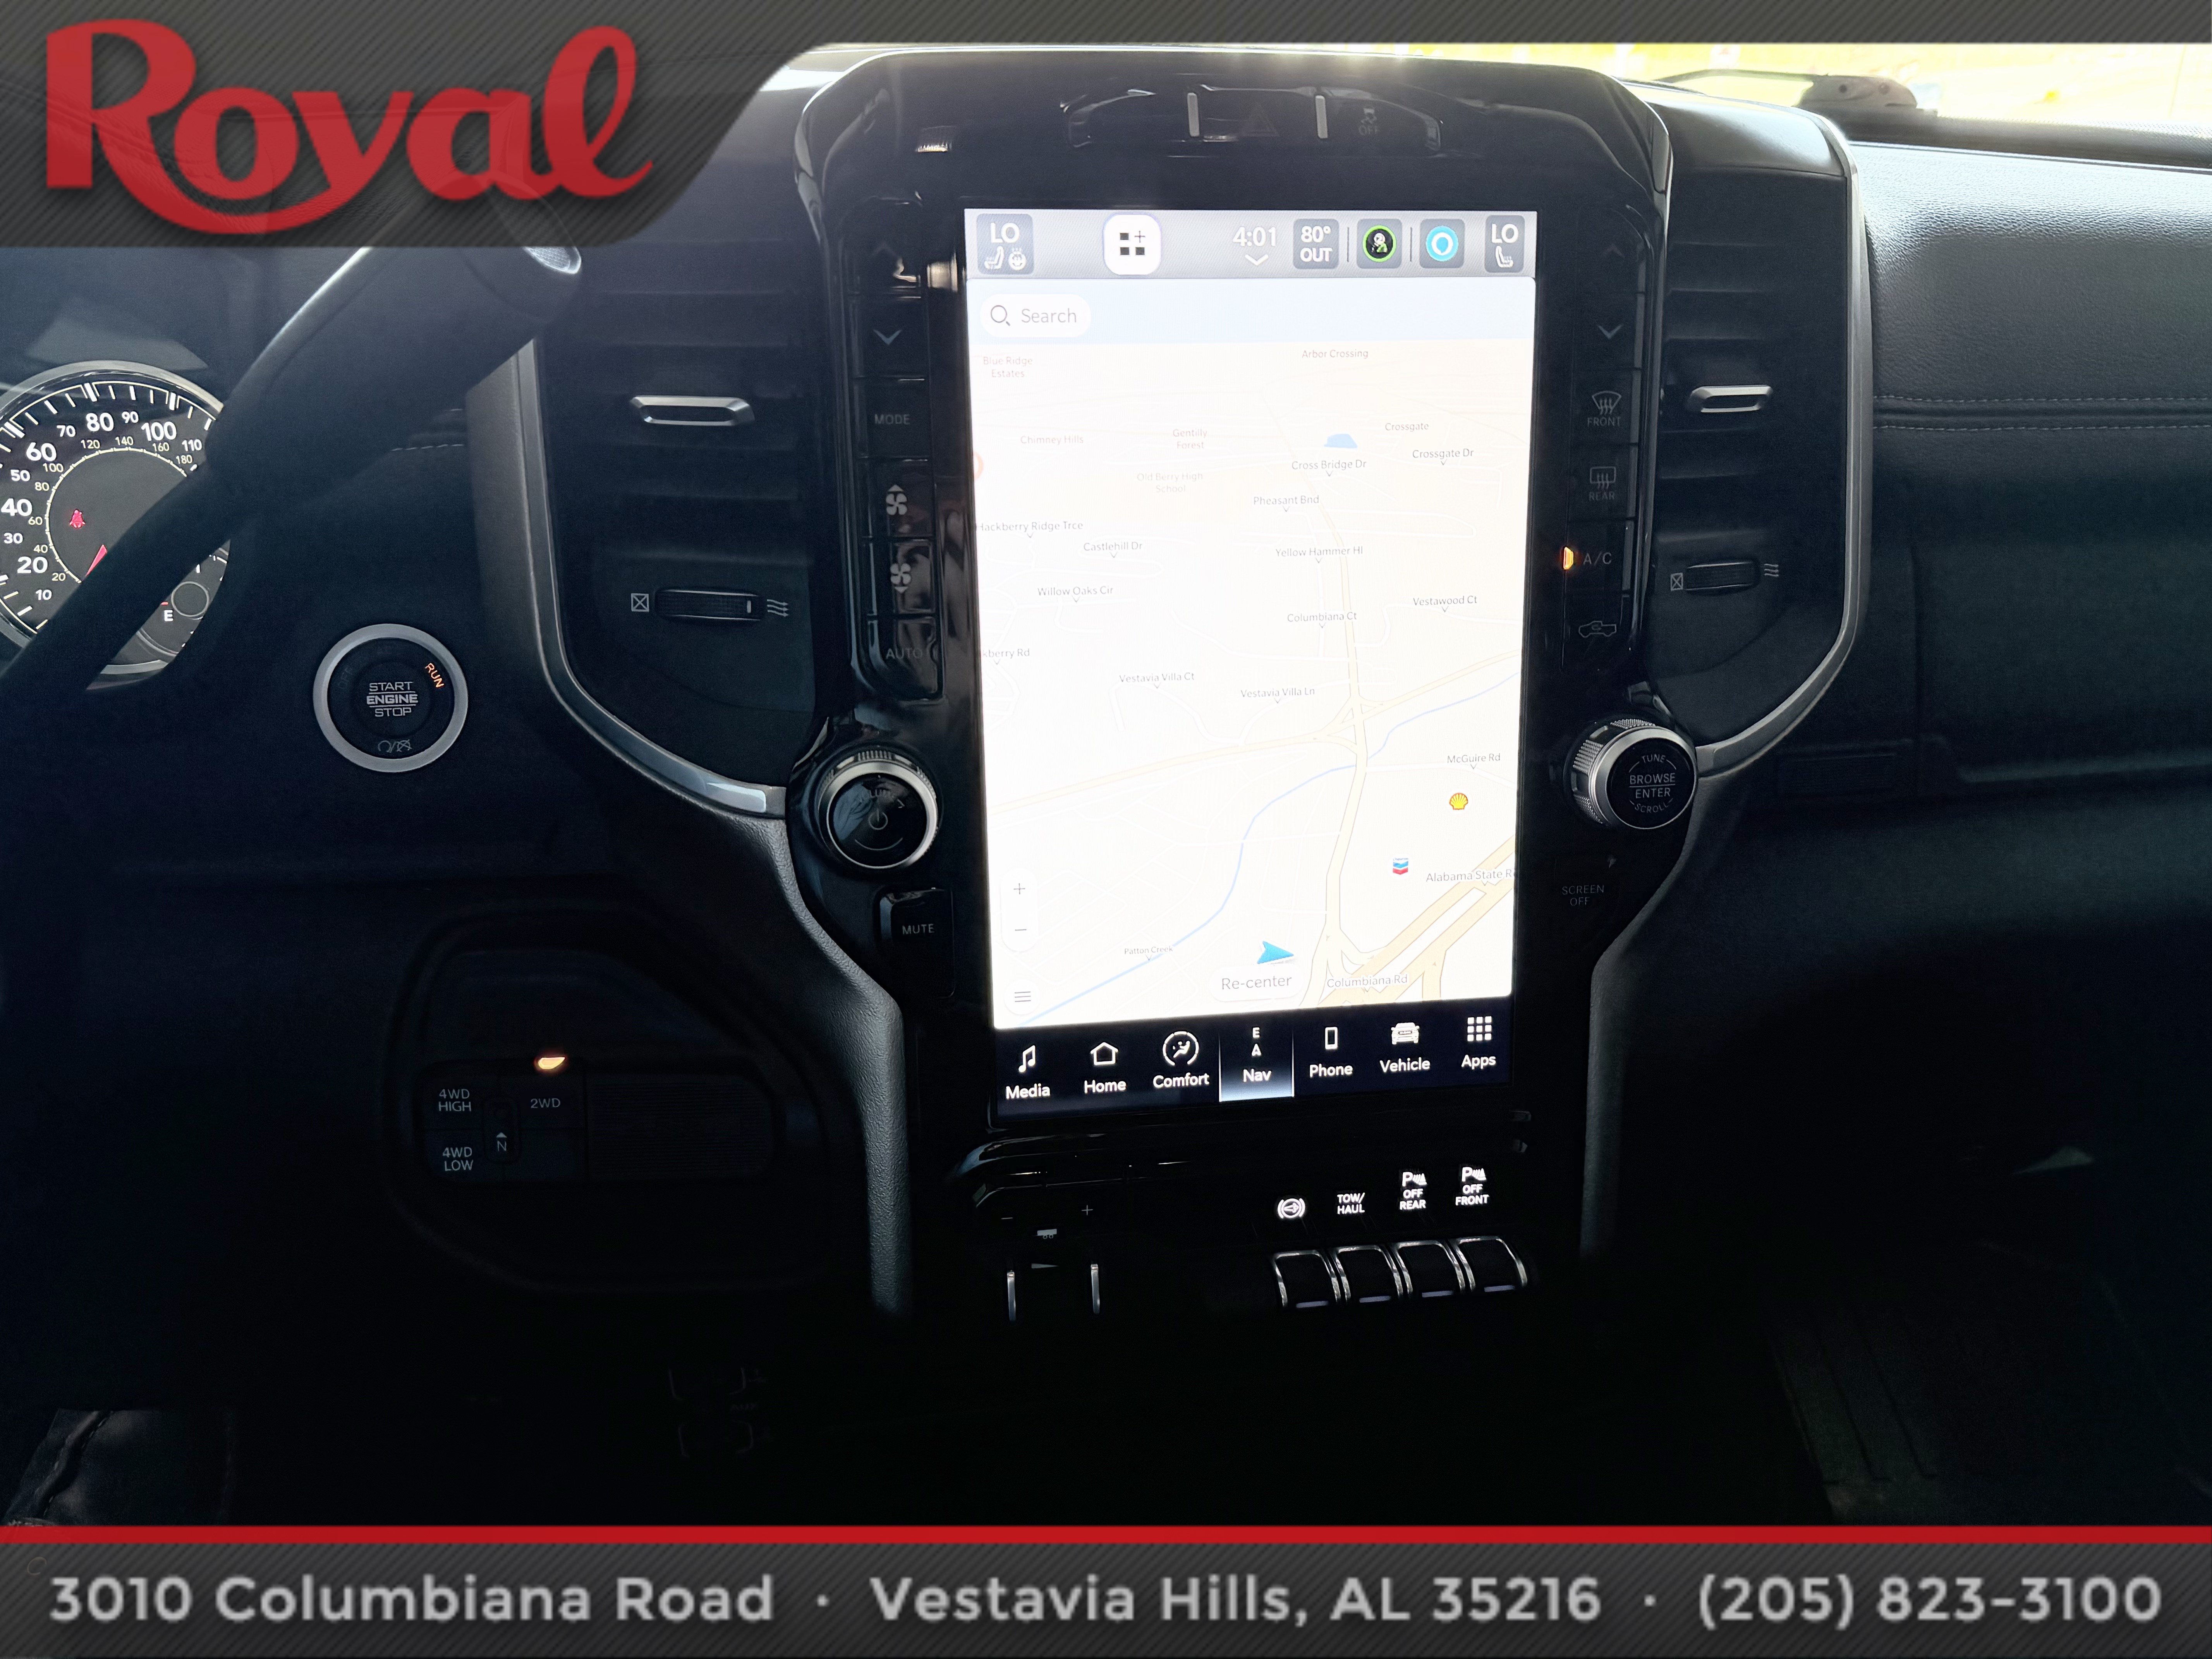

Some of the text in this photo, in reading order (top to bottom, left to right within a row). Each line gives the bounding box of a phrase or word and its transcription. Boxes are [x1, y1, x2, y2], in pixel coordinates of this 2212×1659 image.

[991, 223, 1020, 243] LO
[1233, 227, 1276, 246] 4:01
[1492, 224, 1518, 243] LO
[1300, 248, 1333, 262] OUT
[1022, 308, 1076, 323] Search
[1330, 350, 1368, 359] Crossing
[983, 356, 1032, 366] Blue Ridge
[992, 369, 1024, 378] Estates
[86, 413, 113, 431] 80
[122, 411, 138, 423] 90
[875, 414, 909, 424] MODE
[1588, 416, 1621, 426] FRONT
[57, 425, 76, 437] 70
[141, 422, 176, 441] 100
[1385, 423, 1429, 432] Crossgate
[1173, 429, 1207, 438] Gentilly
[81, 440, 100, 449] 120
[115, 436, 133, 445] 140
[182, 440, 202, 451] 110
[1020, 436, 1061, 445] Chimney
[26, 442, 56, 461] 60
[153, 442, 169, 452] 160
[1412, 448, 1474, 459] Crossgate Dr
[176, 455, 192, 464] 180
[43, 463, 64, 472] 100
[1292, 459, 1366, 471] Cross Bridge Dr
[11, 470, 30, 481] 50
[1156, 473, 1179, 482] Berry
[1182, 473, 1203, 482] High
[35, 482, 49, 491] 80
[1301, 495, 1319, 504] Bnd
[1589, 491, 1615, 500] REAR
[1, 498, 32, 516] 40
[28, 517, 43, 525] 60
[1032, 522, 1060, 532] Ridge
[4, 533, 22, 544] 30
[34, 545, 48, 553] 40
[1084, 542, 1128, 551] Castlehill
[1276, 548, 1306, 556] Yellow
[1309, 548, 1350, 556] Hammer
[1583, 552, 1611, 565] A/C
[17, 556, 47, 573] 20
[52, 572, 66, 581] 20
[36, 590, 52, 600] 10
[1038, 586, 1113, 596] Willow Oaks Cir
[1413, 596, 1464, 605] Vestawood
[164, 610, 173, 622] E
[1287, 612, 1357, 622] Columbiana Ct
[886, 647, 923, 660] AUTO
[425, 663, 444, 687] RUN
[369, 682, 413, 691] START
[367, 694, 418, 705] ENGINE
[374, 707, 411, 717] STOP
[1448, 754, 1486, 763] McGuire
[1642, 754, 1665, 763] TUNE
[1630, 773, 1675, 785] BROWSE
[1636, 788, 1670, 798] ENTER
[1635, 803, 1668, 813] SCROLL
[1426, 870, 1473, 883] Alabama
[1475, 869, 1502, 881] State
[1562, 885, 1604, 895] SCREEN
[1570, 897, 1590, 906] OFF
[902, 924, 933, 934] MUTE
[1222, 976, 1291, 990] Re-center
[1326, 973, 1407, 989] Columbiana Rd
[1253, 1027, 1259, 1038] E
[1380, 1057, 1430, 1072] Vehicle
[1462, 1055, 1496, 1070] Apps
[1243, 1069, 1271, 1082] Nav
[1310, 1064, 1353, 1077] Phone
[1153, 1072, 1209, 1089] Comfort
[1006, 1084, 1050, 1099] Media
[1084, 1080, 1126, 1094] Home
[439, 1089, 470, 1099] 4WD
[439, 1101, 471, 1111] HIGH
[531, 1098, 560, 1108] 2WD
[497, 1141, 507, 1151] N
[443, 1147, 472, 1158] 4WD
[445, 1160, 473, 1171] LOW
[1403, 1188, 1423, 1199] OFF
[1463, 1184, 1482, 1194] OFF
[1337, 1193, 1365, 1204] TOW/
[1456, 1194, 1489, 1206] FRONT
[1338, 1203, 1365, 1214] HAUL
[1400, 1200, 1426, 1210] REAR
